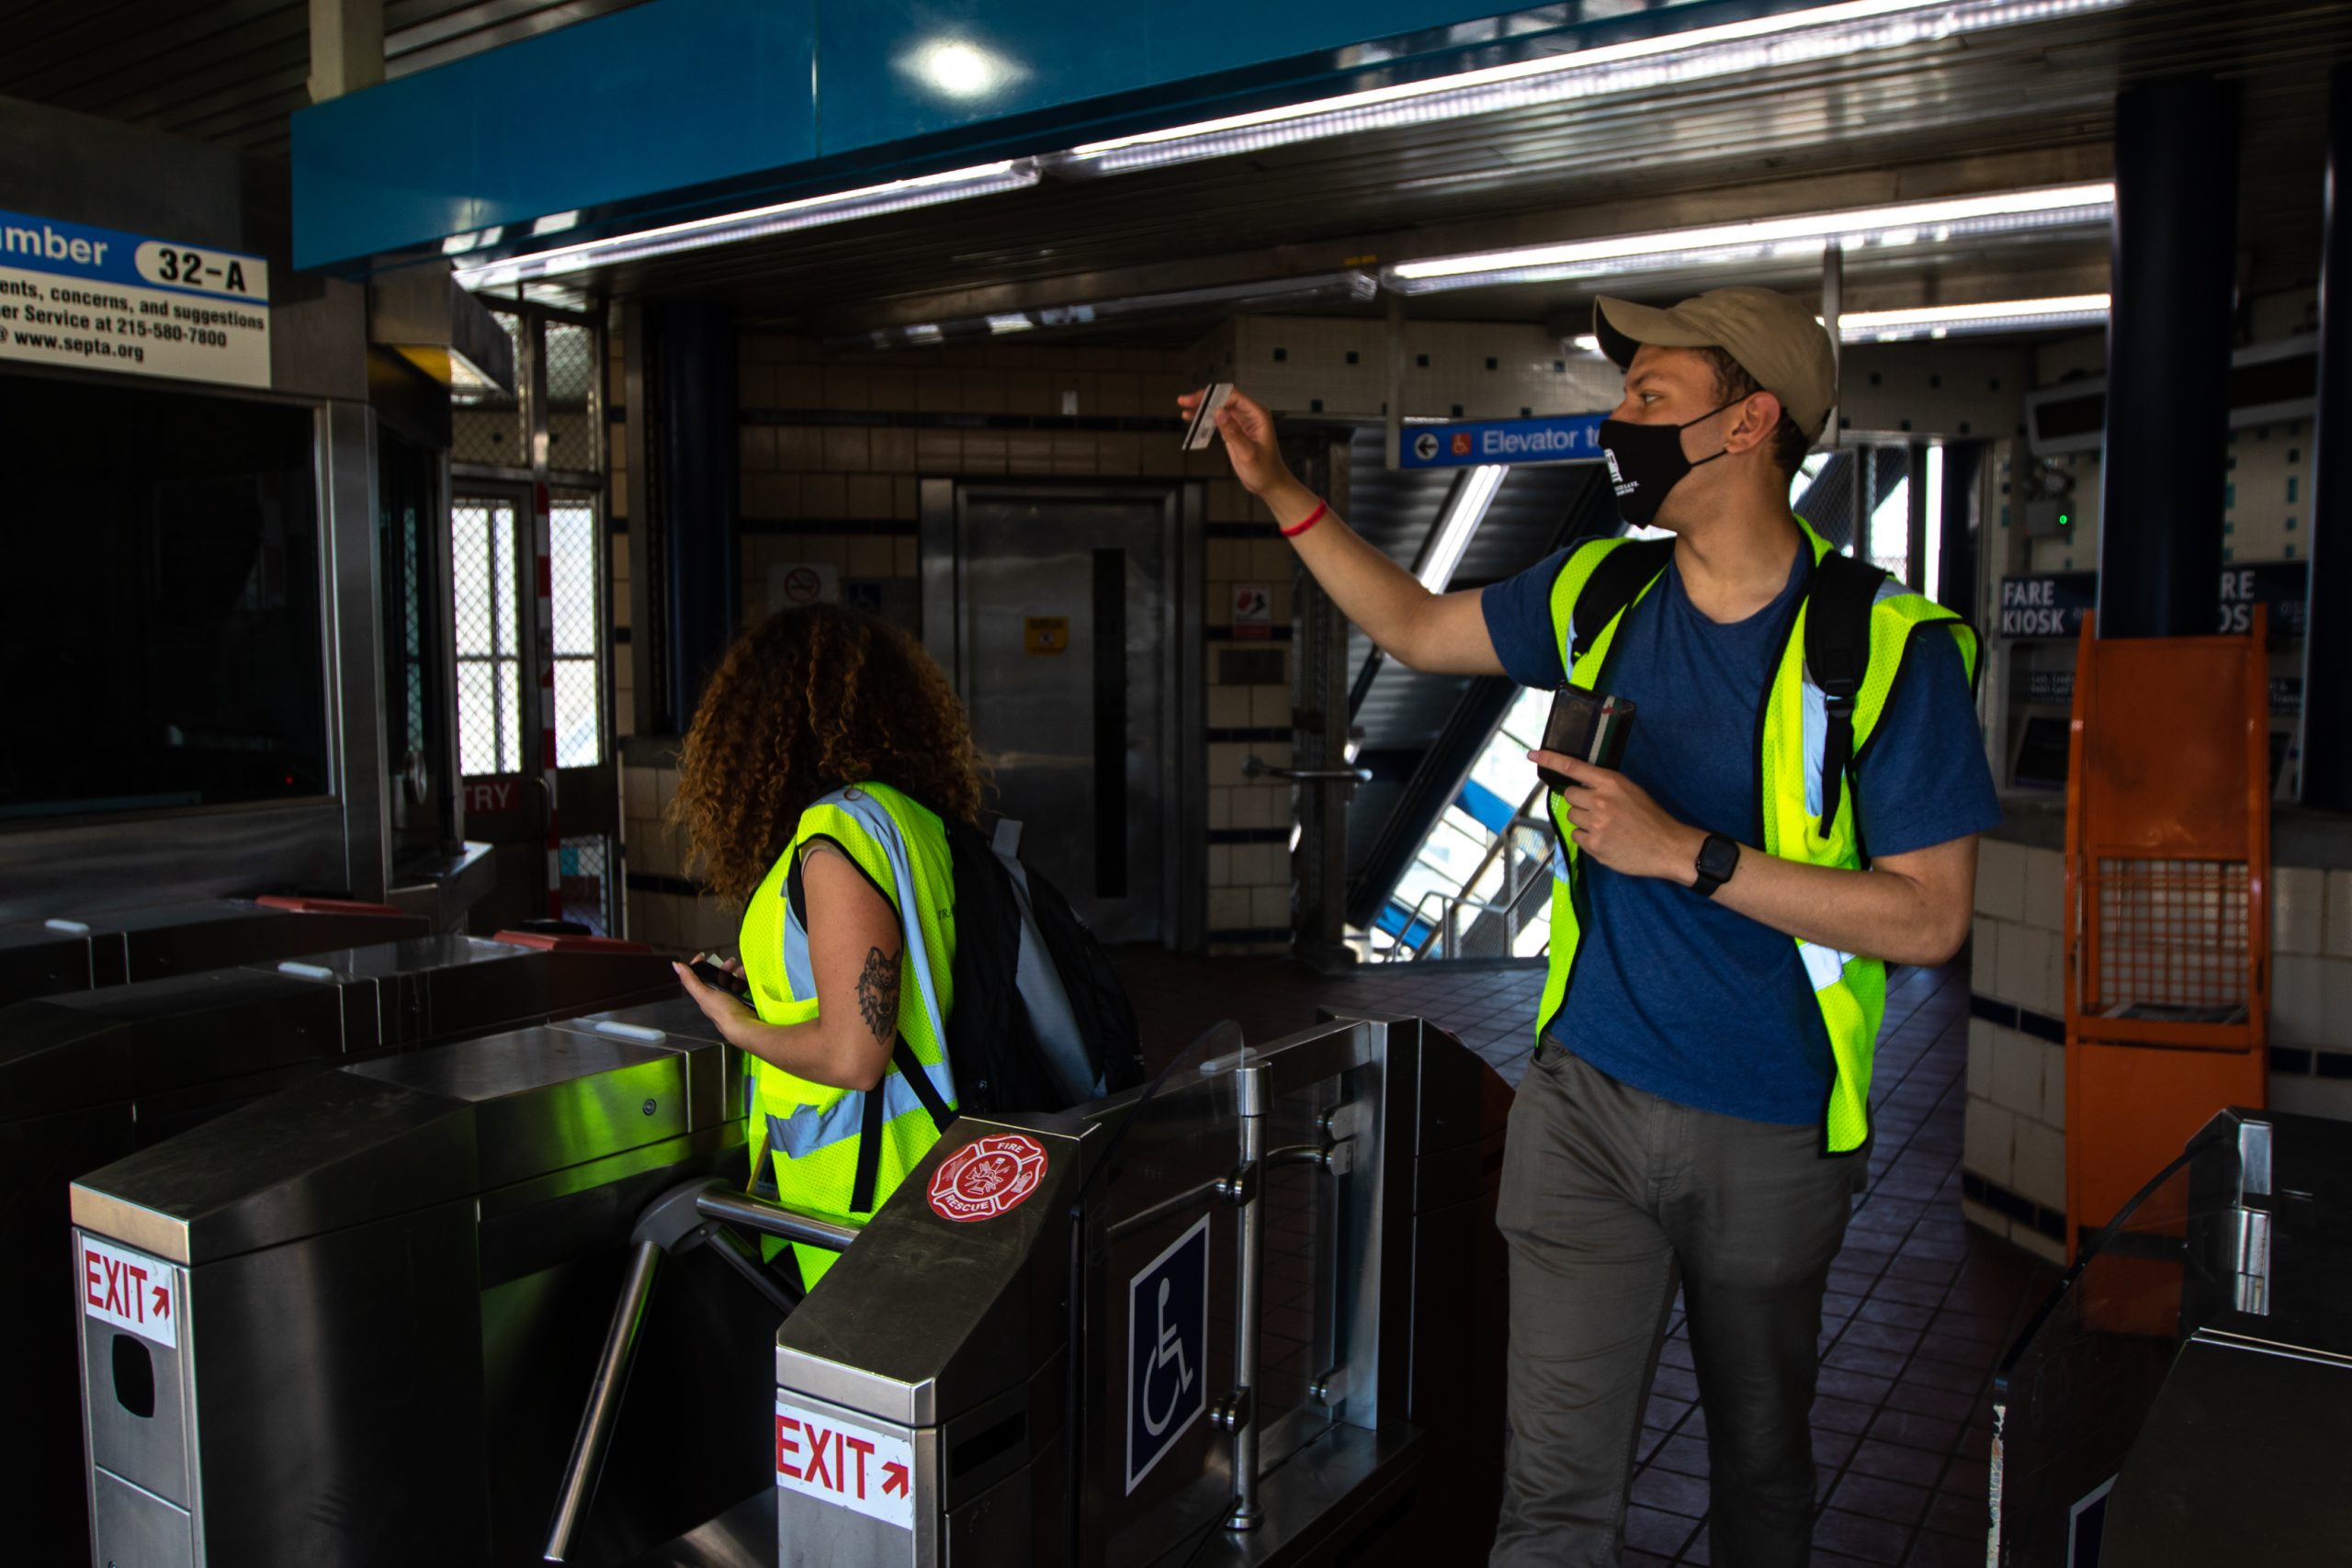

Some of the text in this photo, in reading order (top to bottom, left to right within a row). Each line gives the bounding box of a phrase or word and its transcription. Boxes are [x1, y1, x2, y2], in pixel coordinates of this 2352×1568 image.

[0, 225, 108, 266] mber
[158, 247, 246, 292] 32-A
[25, 305, 89, 329] Service
[96, 316, 111, 332] at
[118, 318, 227, 346] 215-580-7800
[51, 287, 133, 313] concerns,
[140, 299, 169, 317] and
[174, 304, 265, 331] suggestions
[15, 332, 144, 362] www.septa.org
[1481, 427, 1578, 455] Elevator
[2004, 580, 2055, 606] FARE
[2002, 608, 2066, 635] KIOSK
[997, 1142, 1025, 1154] FIRE
[944, 1193, 989, 1213] RESCUE
[85, 1249, 147, 1324] EXIT
[775, 1414, 875, 1500] EXIT
